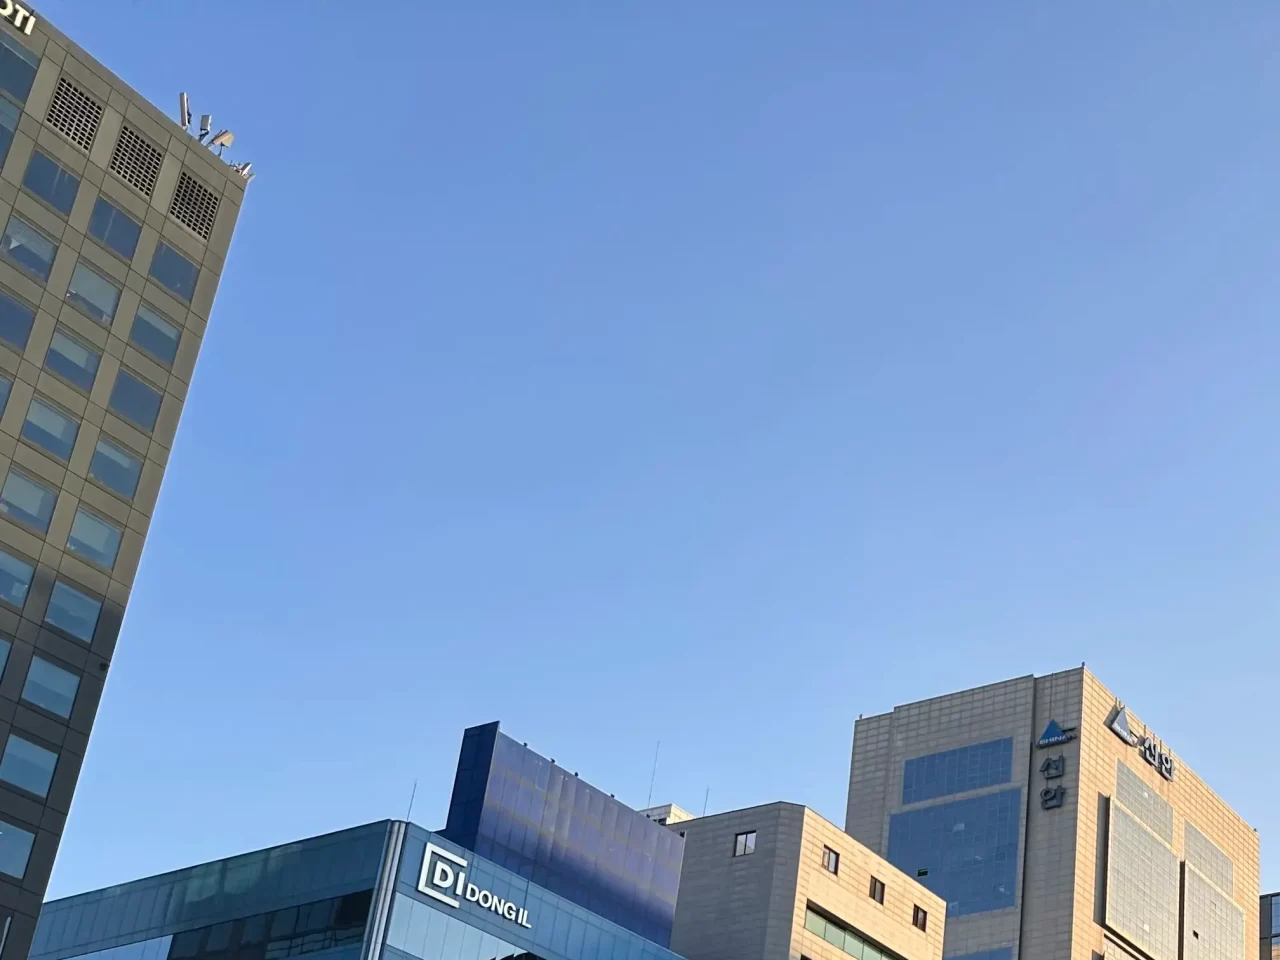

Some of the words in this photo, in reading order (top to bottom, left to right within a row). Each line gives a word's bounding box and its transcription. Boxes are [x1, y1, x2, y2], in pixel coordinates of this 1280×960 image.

[1140, 737, 1174, 782] 신안
[1039, 755, 1066, 811] 신안
[465, 883, 533, 929] DONGIL
